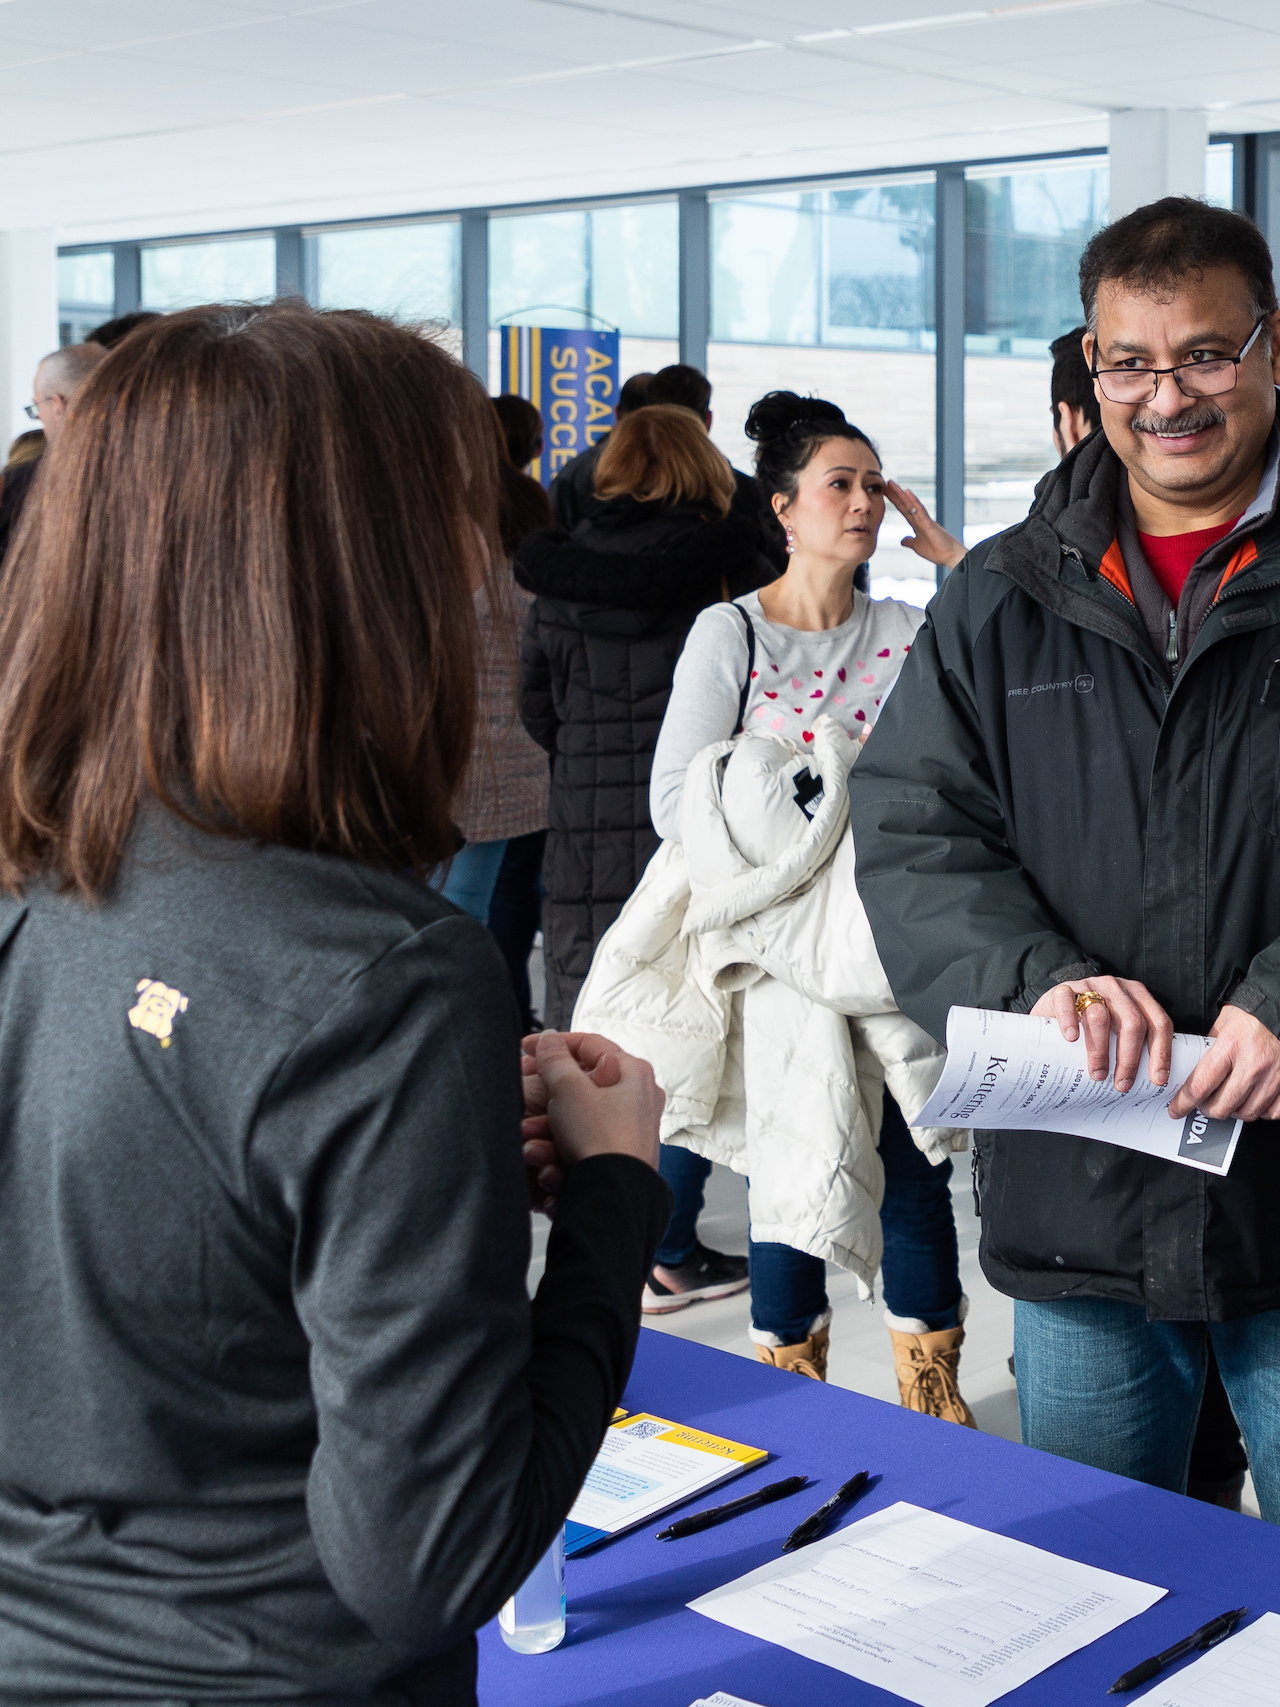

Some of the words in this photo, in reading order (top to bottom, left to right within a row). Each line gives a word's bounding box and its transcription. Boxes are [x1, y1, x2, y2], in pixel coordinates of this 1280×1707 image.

[551, 346, 578, 479] SUCCE
[1008, 688, 1029, 698] FREE
[1031, 680, 1074, 694] COUNTRY
[1041, 1063, 1050, 1079] 2:05
[950, 1055, 1008, 1119] Kettering
[676, 1431, 736, 1455] Kettering
